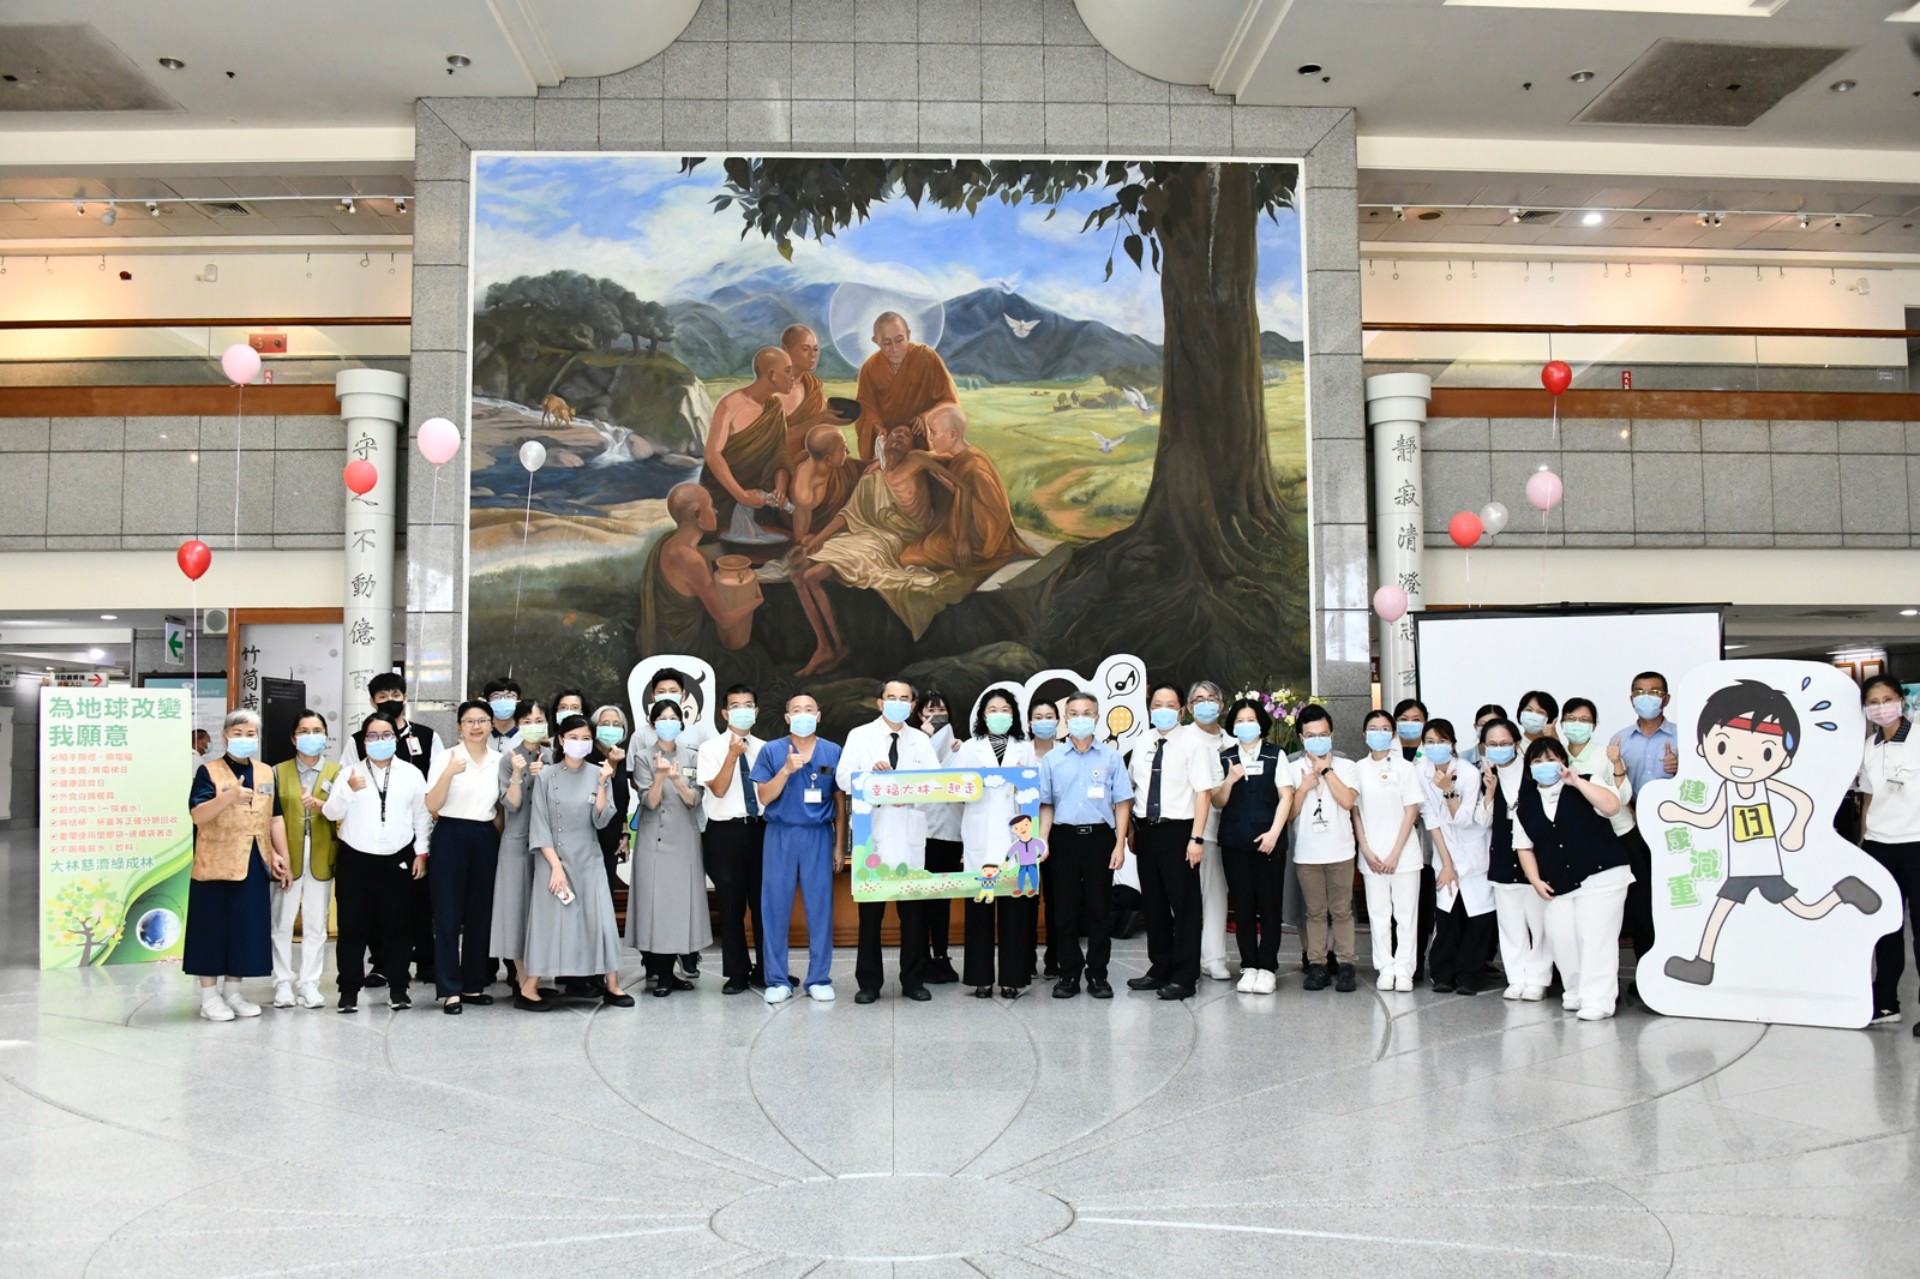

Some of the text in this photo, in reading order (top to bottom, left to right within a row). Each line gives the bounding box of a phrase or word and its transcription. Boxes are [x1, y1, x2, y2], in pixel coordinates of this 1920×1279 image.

[48, 696, 182, 720] 為地球改變
[48, 724, 129, 748] 我願意
[872, 782, 975, 796] 幸福大林一起走
[1739, 807, 1764, 837] 13
